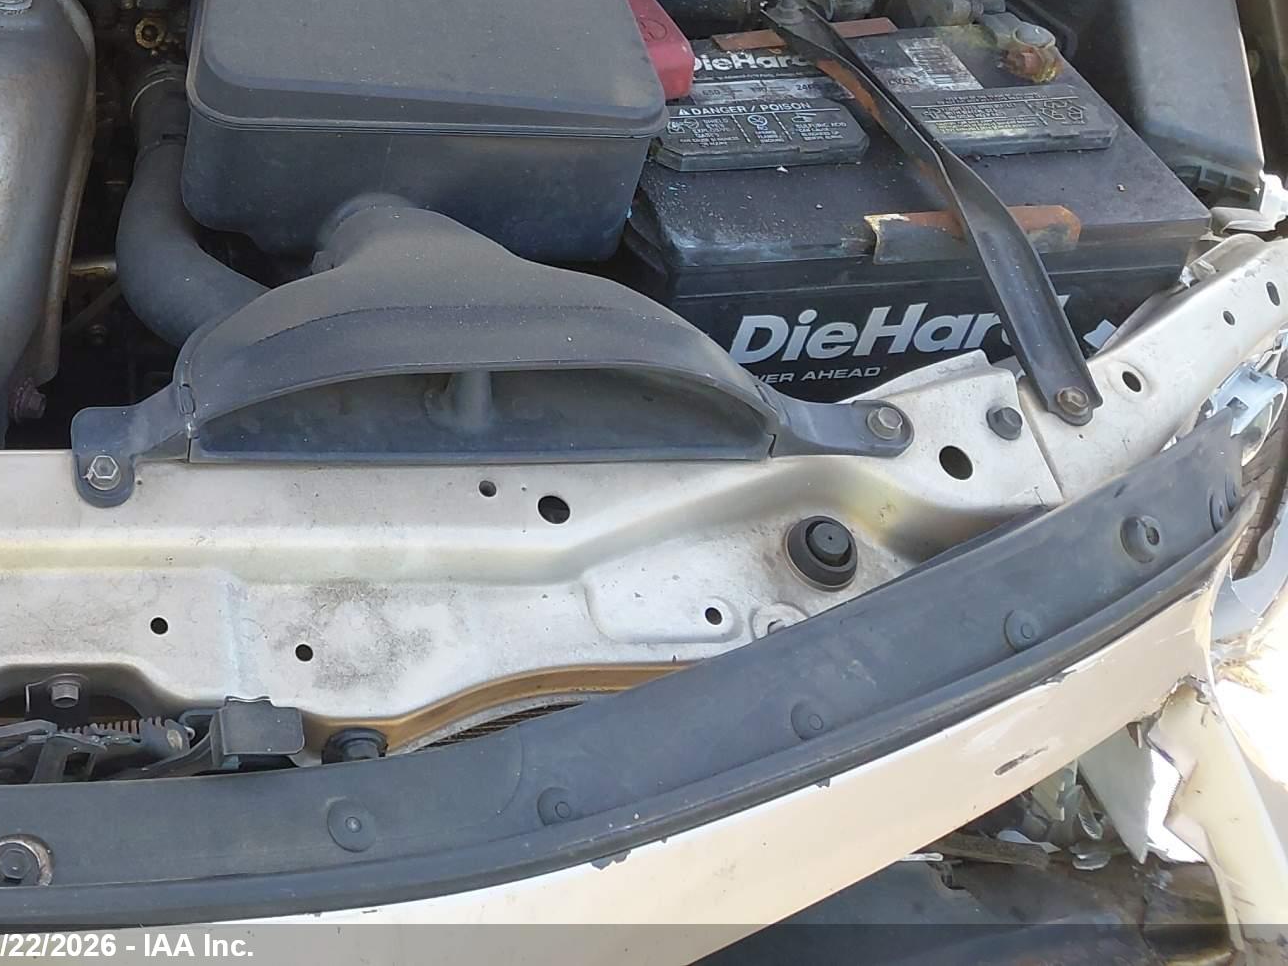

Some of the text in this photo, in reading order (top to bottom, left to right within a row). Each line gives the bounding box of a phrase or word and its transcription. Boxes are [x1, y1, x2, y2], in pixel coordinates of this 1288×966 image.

[691, 105, 748, 115] DANGER
[759, 102, 812, 112] POISON
[729, 294, 1070, 364] DieHar
[802, 366, 881, 381] AHEAD
